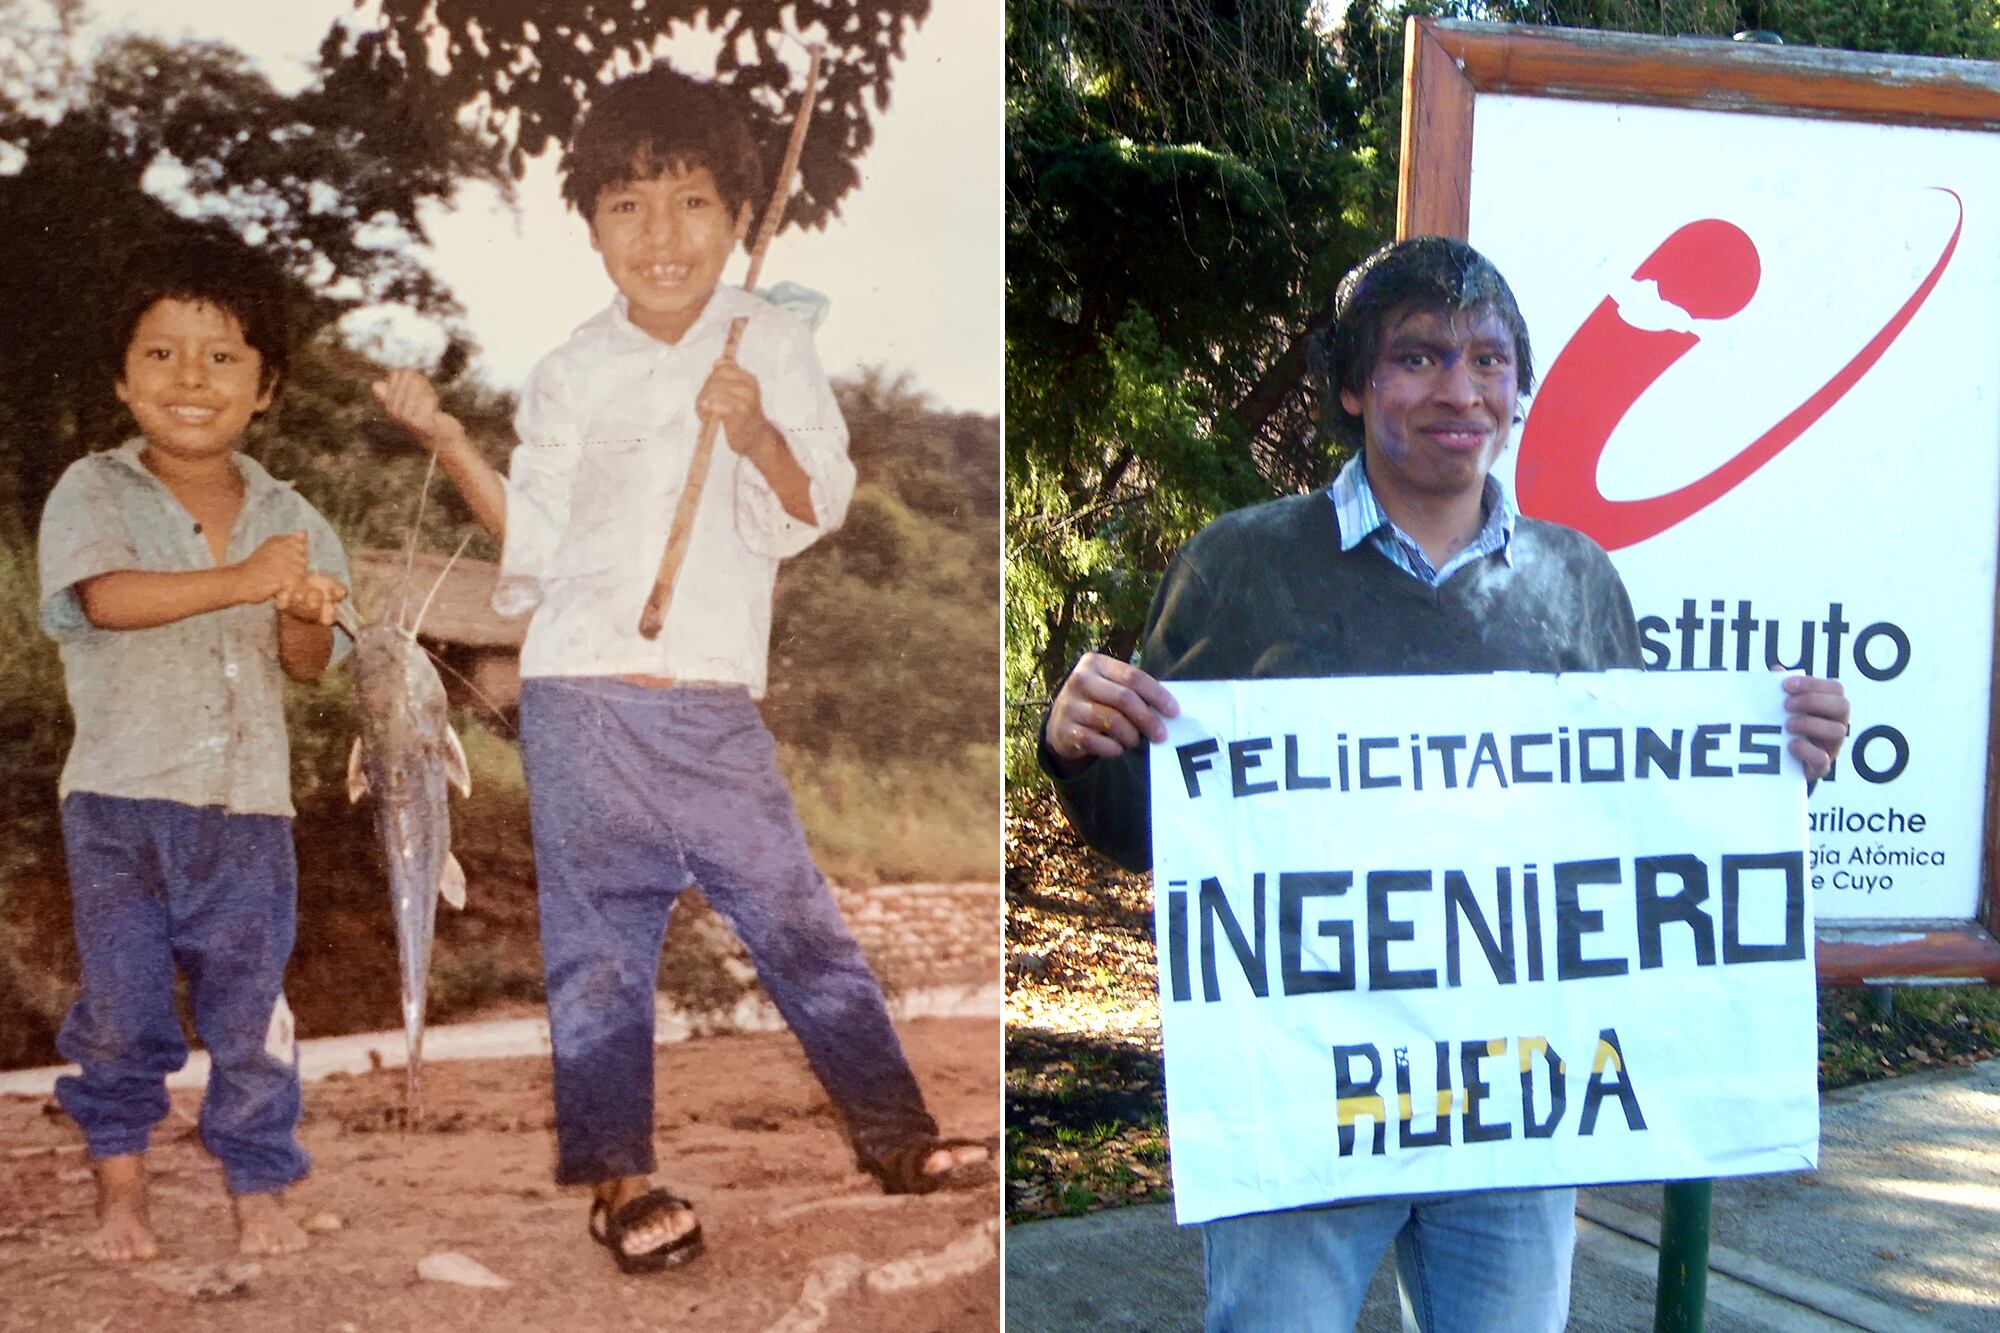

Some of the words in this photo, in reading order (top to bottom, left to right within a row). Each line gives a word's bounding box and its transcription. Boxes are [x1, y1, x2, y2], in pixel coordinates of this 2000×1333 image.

[1848, 842, 1946, 867] Atómica
[1832, 870, 1894, 895] Cuyo
[1332, 1028, 1648, 1158] RUEDA
